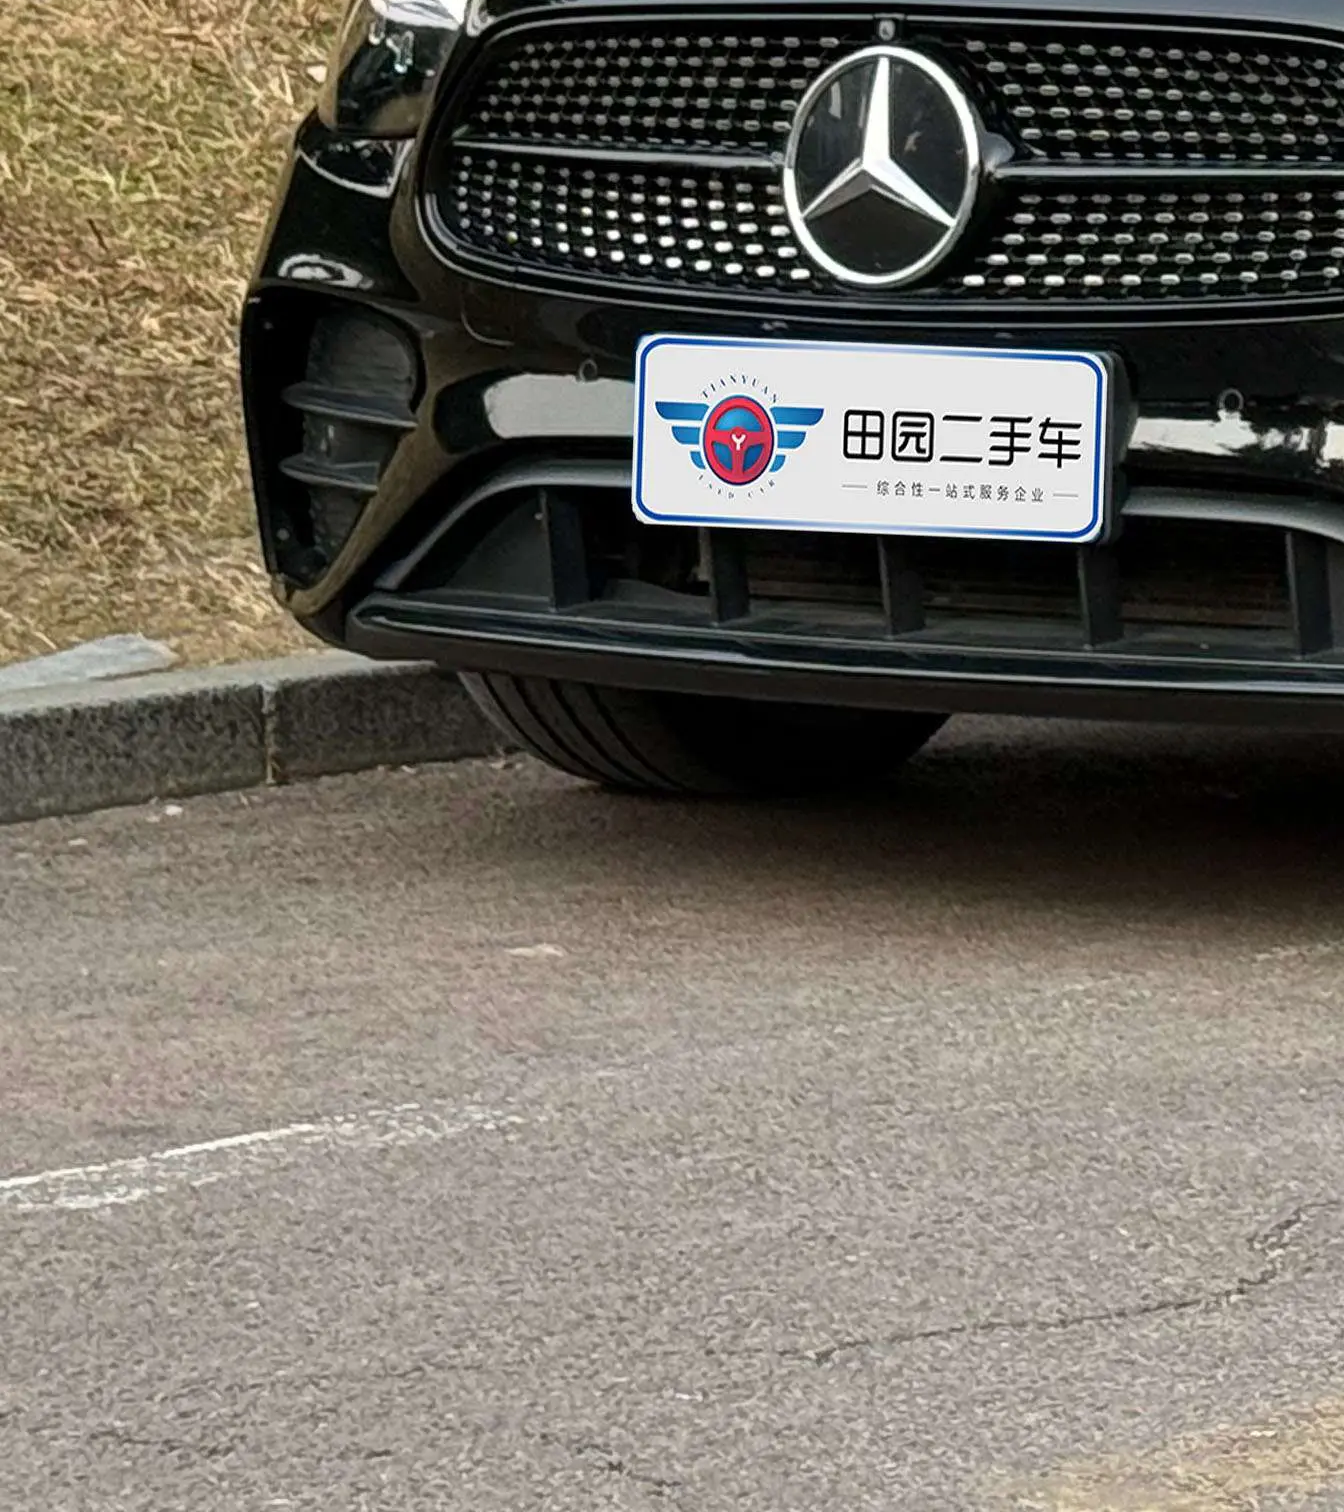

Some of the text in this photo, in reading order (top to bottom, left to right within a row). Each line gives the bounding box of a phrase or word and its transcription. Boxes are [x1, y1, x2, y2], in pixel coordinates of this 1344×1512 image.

[843, 409, 1082, 469] 田园二手车
[877, 480, 1044, 503] 综合性一站式服务企业
